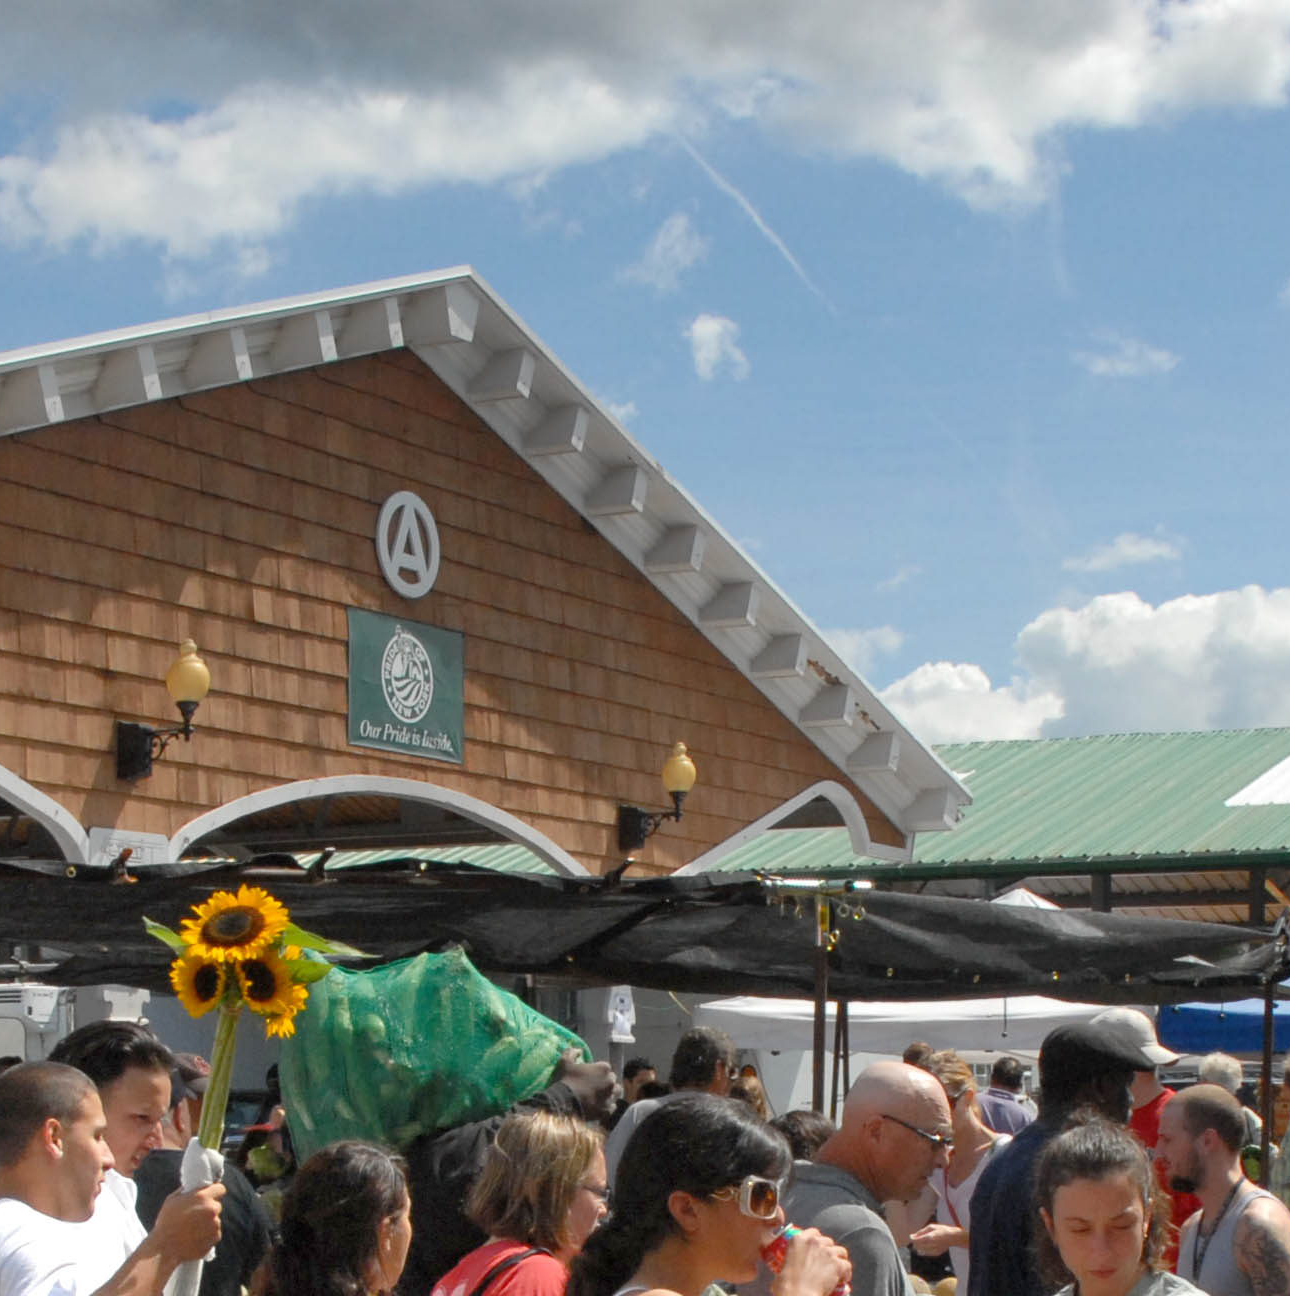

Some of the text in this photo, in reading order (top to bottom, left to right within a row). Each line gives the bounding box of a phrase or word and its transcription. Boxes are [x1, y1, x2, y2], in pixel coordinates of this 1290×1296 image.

[391, 682, 431, 718] NEW YORK
[360, 719, 382, 739] Our
[383, 723, 411, 745] Pride
[412, 728, 421, 746] is
